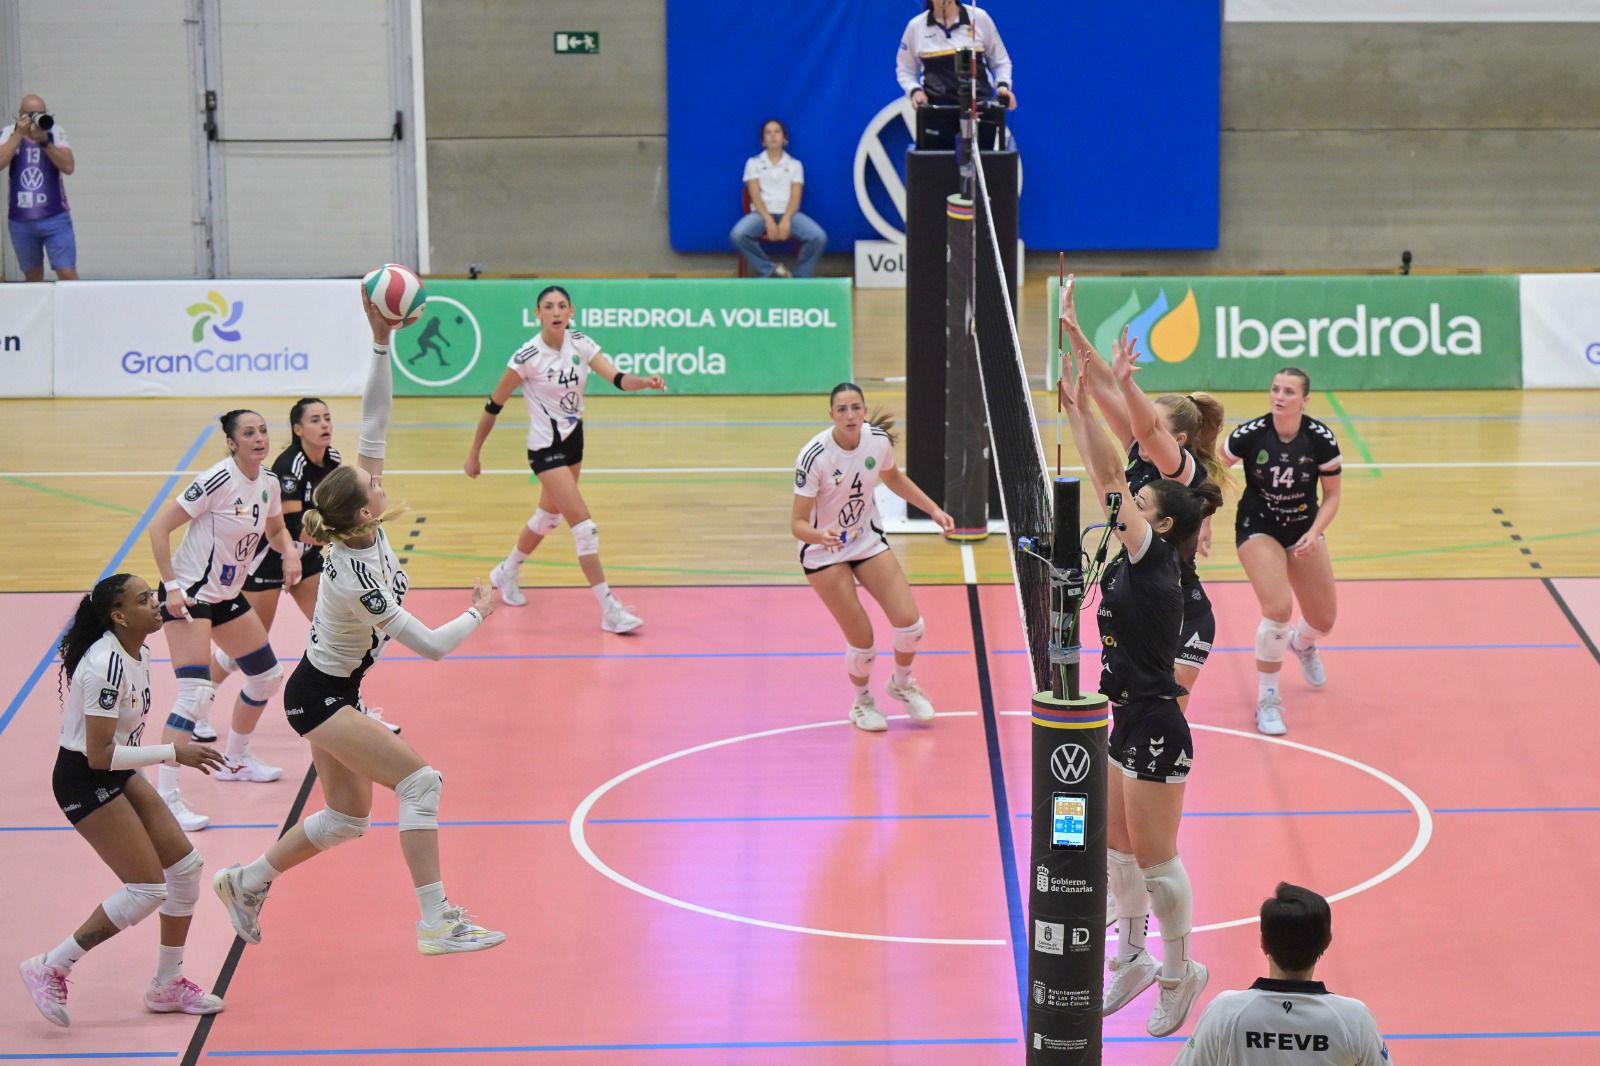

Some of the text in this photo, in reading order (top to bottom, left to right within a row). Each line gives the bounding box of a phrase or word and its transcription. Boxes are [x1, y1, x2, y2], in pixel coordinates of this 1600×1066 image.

[26, 147, 41, 163] 13
[581, 308, 715, 327] IBERDROLA
[721, 308, 837, 327] VOLEIBOL
[1215, 302, 1482, 360] Iberdrola
[122, 347, 309, 374] GranCanaria
[600, 346, 726, 375] erdrola
[558, 367, 579, 389] 44
[850, 472, 863, 493] 4
[1269, 465, 1295, 488] 14
[252, 503, 260, 527] 9
[1147, 760, 1157, 773] 4
[1050, 877, 1087, 886] Gobierno
[1060, 885, 1093, 893] Canarias
[1245, 1031, 1329, 1052] RFEVB
